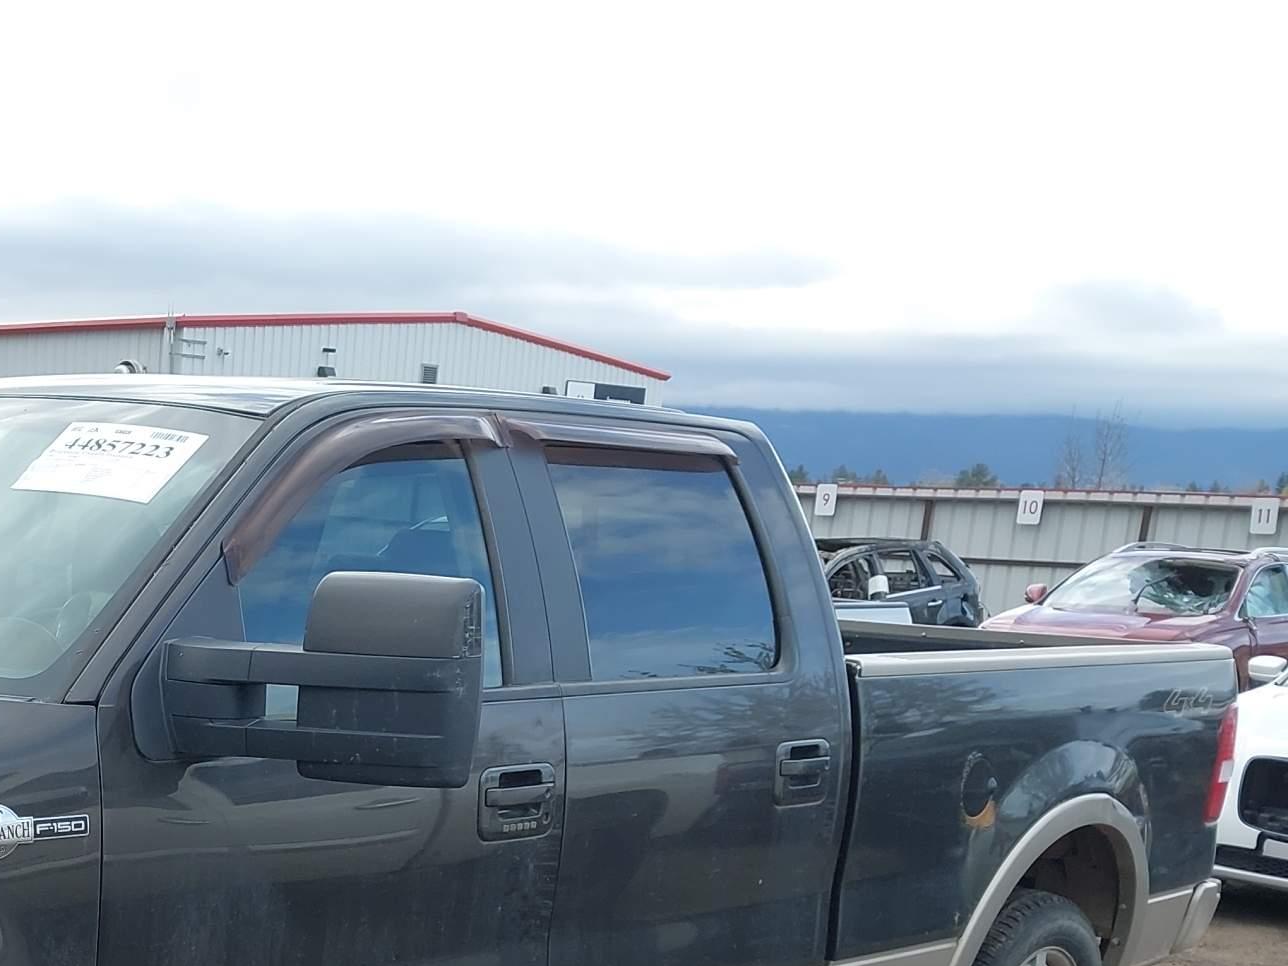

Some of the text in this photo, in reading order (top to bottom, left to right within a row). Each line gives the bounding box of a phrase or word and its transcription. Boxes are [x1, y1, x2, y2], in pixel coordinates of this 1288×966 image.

[64, 437, 175, 459] 44857223
[822, 493, 831, 507] 9
[1022, 500, 1039, 515] 10
[1257, 508, 1271, 524] 11
[1164, 687, 1213, 717] 4x4
[36, 820, 85, 835] F-150
